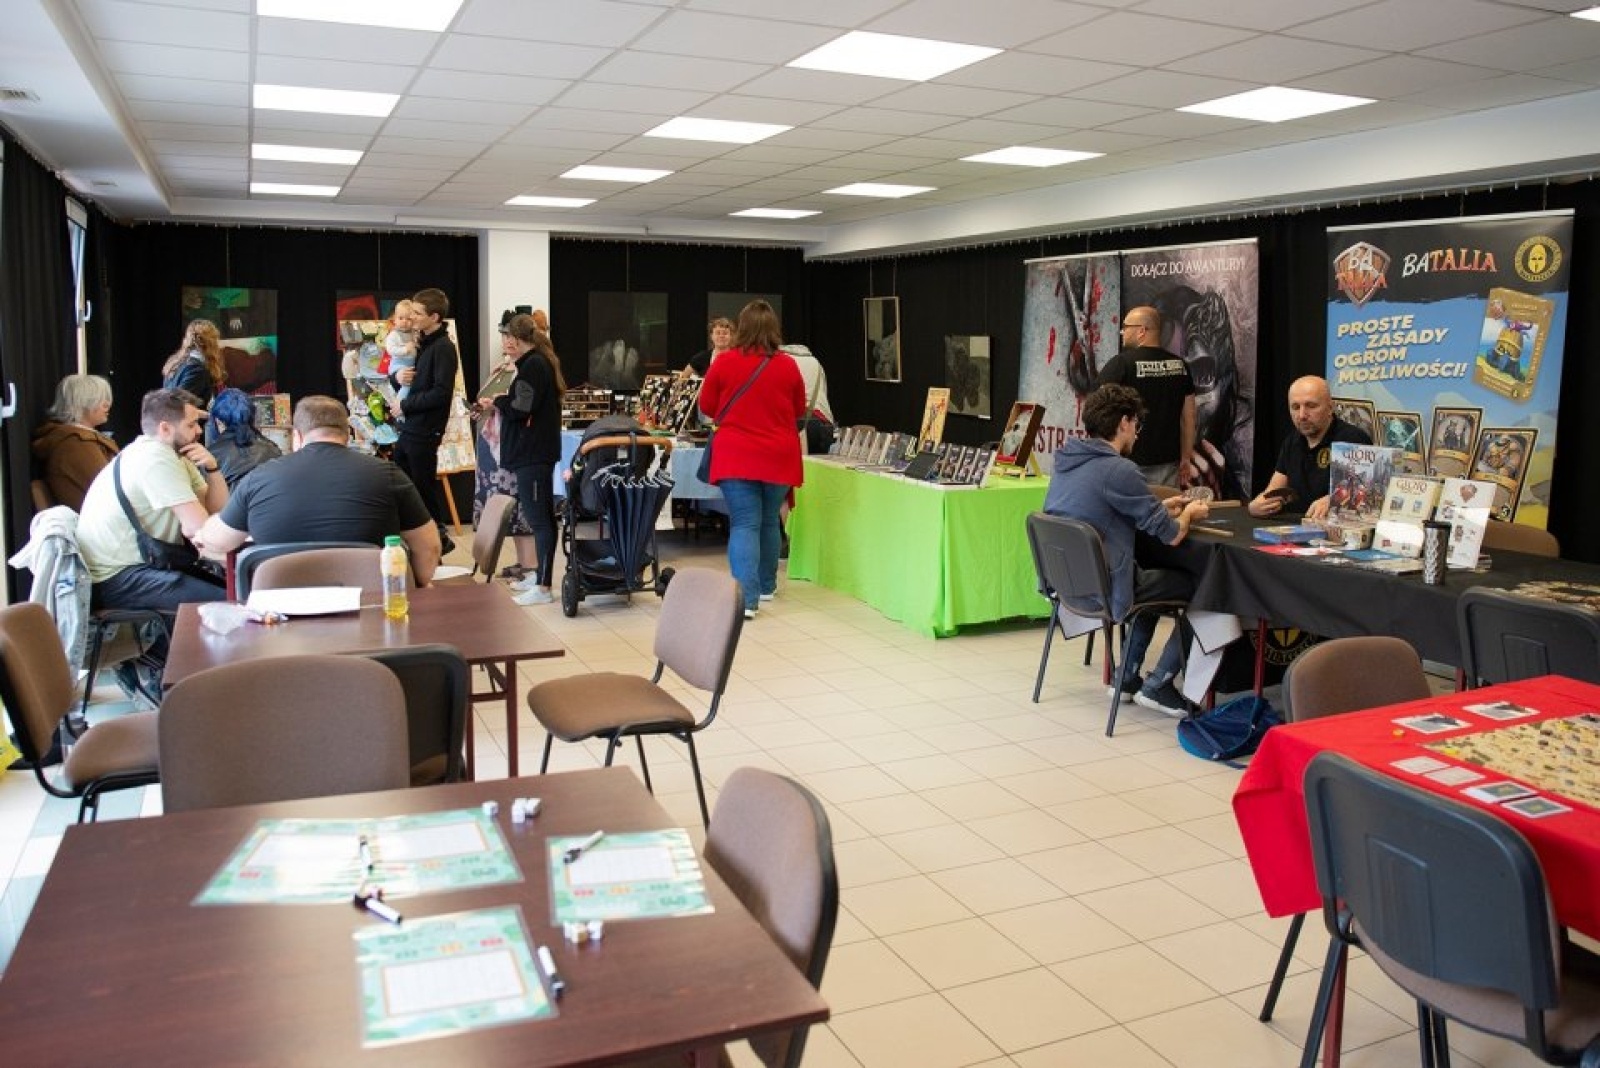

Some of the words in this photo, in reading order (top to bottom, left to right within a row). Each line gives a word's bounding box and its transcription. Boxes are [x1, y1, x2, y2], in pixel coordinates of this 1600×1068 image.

[1131, 262, 1167, 279] DOŁĄCZ
[1169, 261, 1184, 274] DO
[1402, 248, 1498, 279] BATALIA
[1337, 314, 1414, 337] PROSTE
[1366, 327, 1449, 349] ZASADY
[1334, 346, 1408, 369] OGROM
[1338, 357, 1468, 384] MOŻLIWOŚCI!
[1342, 448, 1376, 464] GLORY
